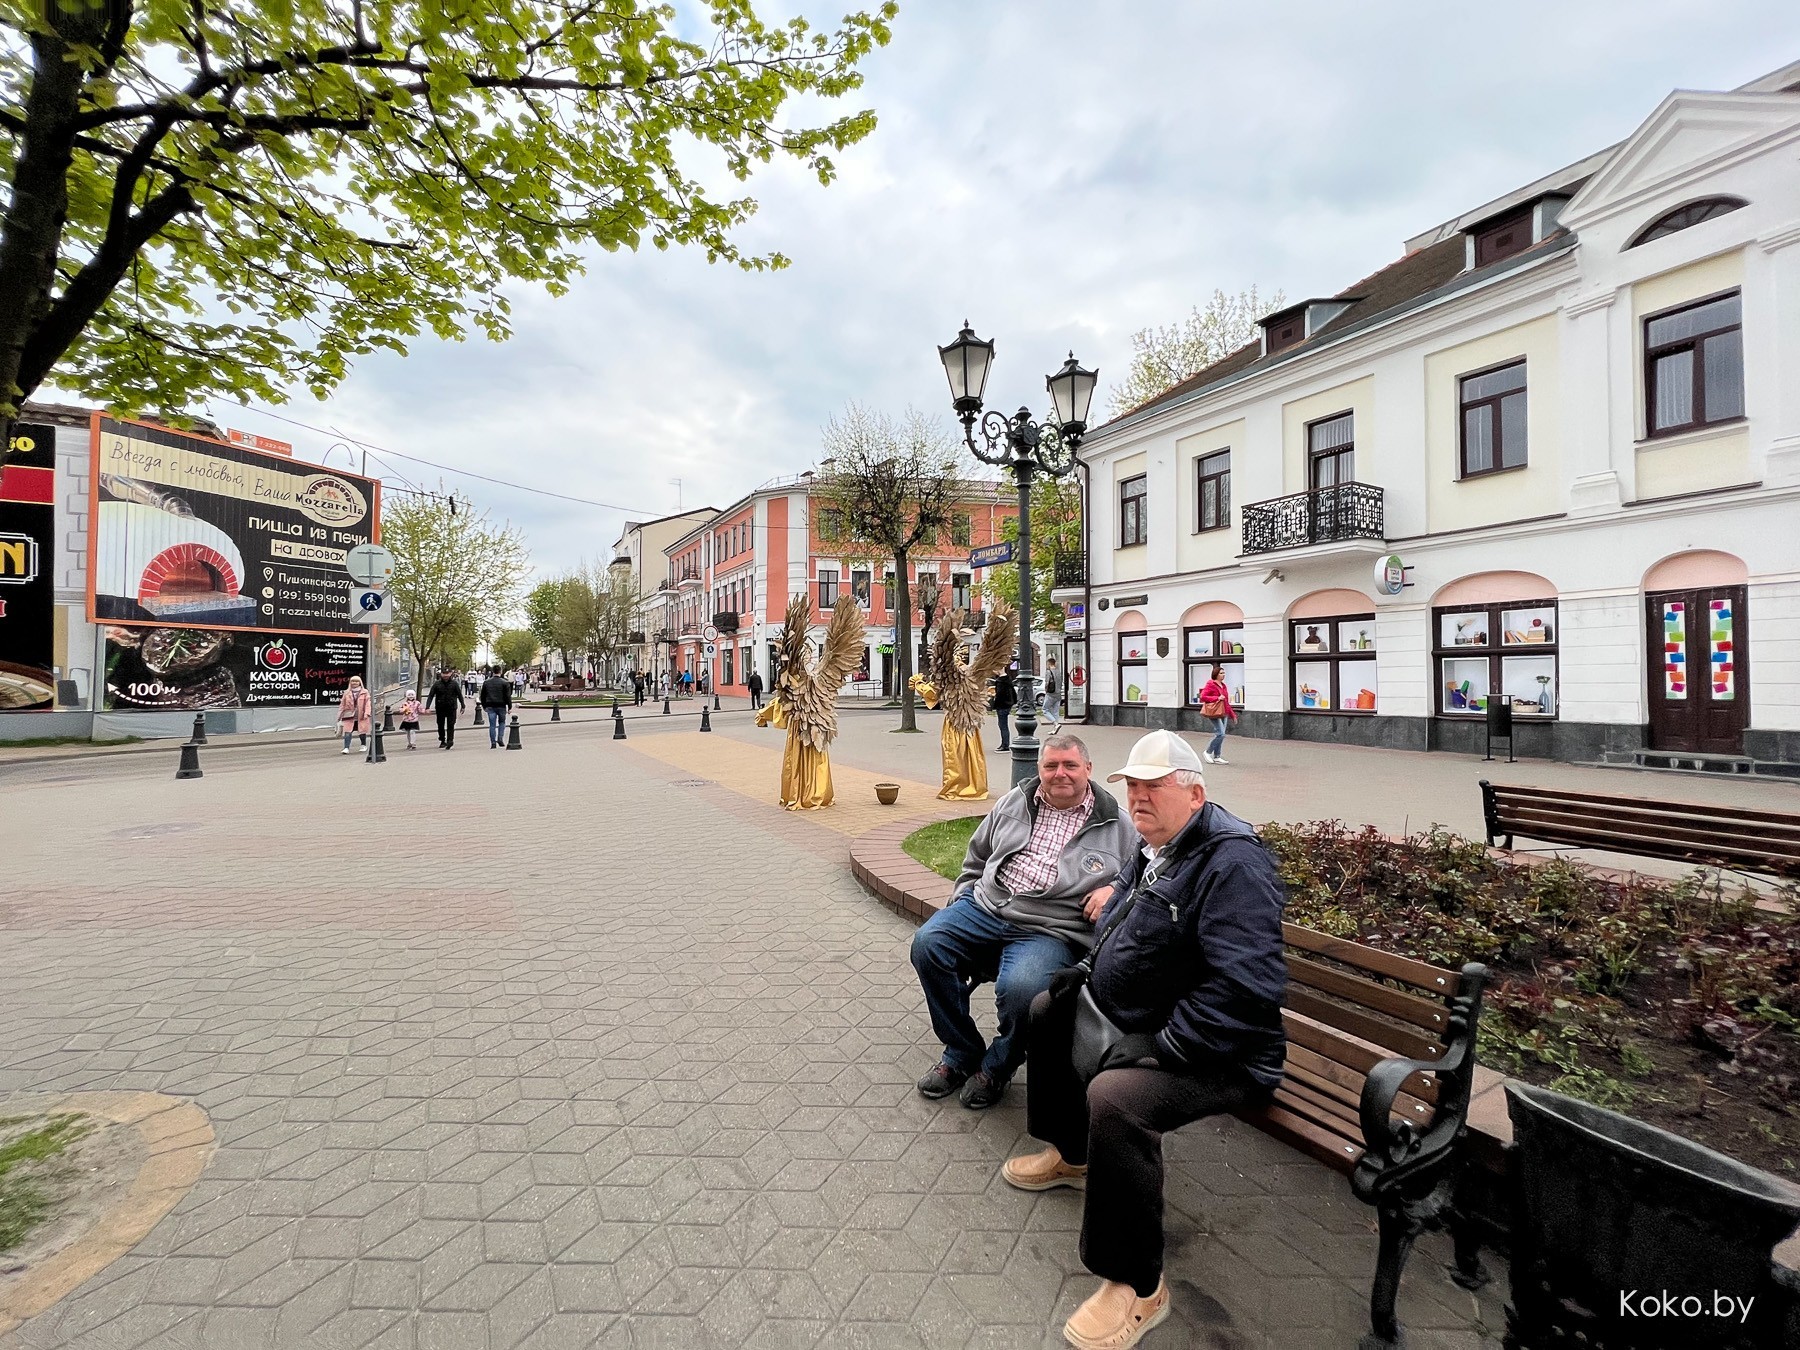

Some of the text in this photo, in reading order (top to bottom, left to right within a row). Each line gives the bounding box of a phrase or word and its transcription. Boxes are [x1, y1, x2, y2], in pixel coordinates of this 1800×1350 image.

[110, 441, 291, 501] Всегда с любовью, Ваша
[295, 492, 364, 516] Mozzarella
[248, 516, 368, 546] пицца из печи
[274, 543, 345, 562] на дровах
[278, 572, 336, 588] Пушкинская
[304, 592, 324, 602] 559
[325, 594, 351, 605] 900
[249, 671, 300, 682] КЛЮКВА
[249, 682, 301, 691] ресторан
